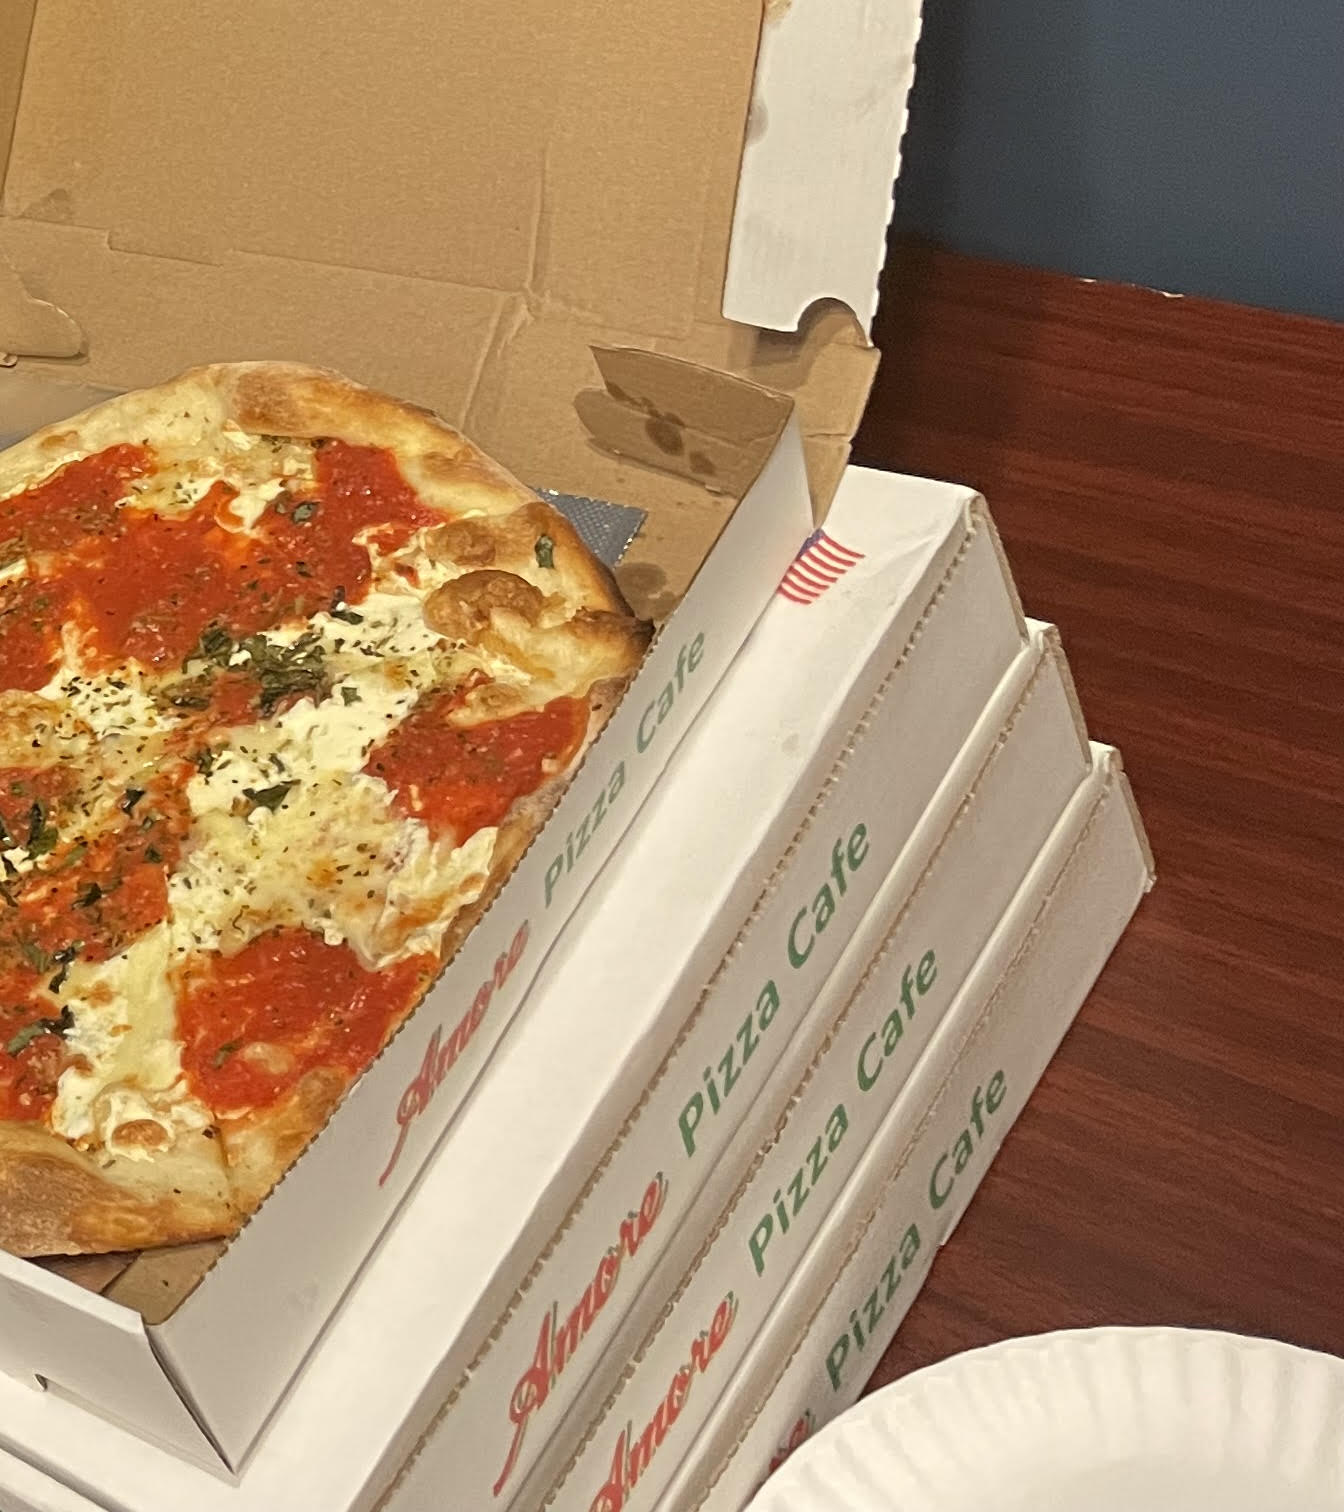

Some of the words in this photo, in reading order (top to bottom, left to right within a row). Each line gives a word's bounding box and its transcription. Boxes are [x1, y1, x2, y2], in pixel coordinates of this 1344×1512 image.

[541, 762, 627, 909] Pizza
[634, 630, 708, 756] Cafe
[491, 1170, 669, 1498] Amore
[676, 978, 782, 1159] Pizza
[785, 821, 871, 970] Cafe
[747, 1101, 850, 1278] Pizza
[855, 947, 939, 1093] Cafe
[824, 1221, 922, 1393] Pizza
[927, 1068, 1008, 1210] Cafe
